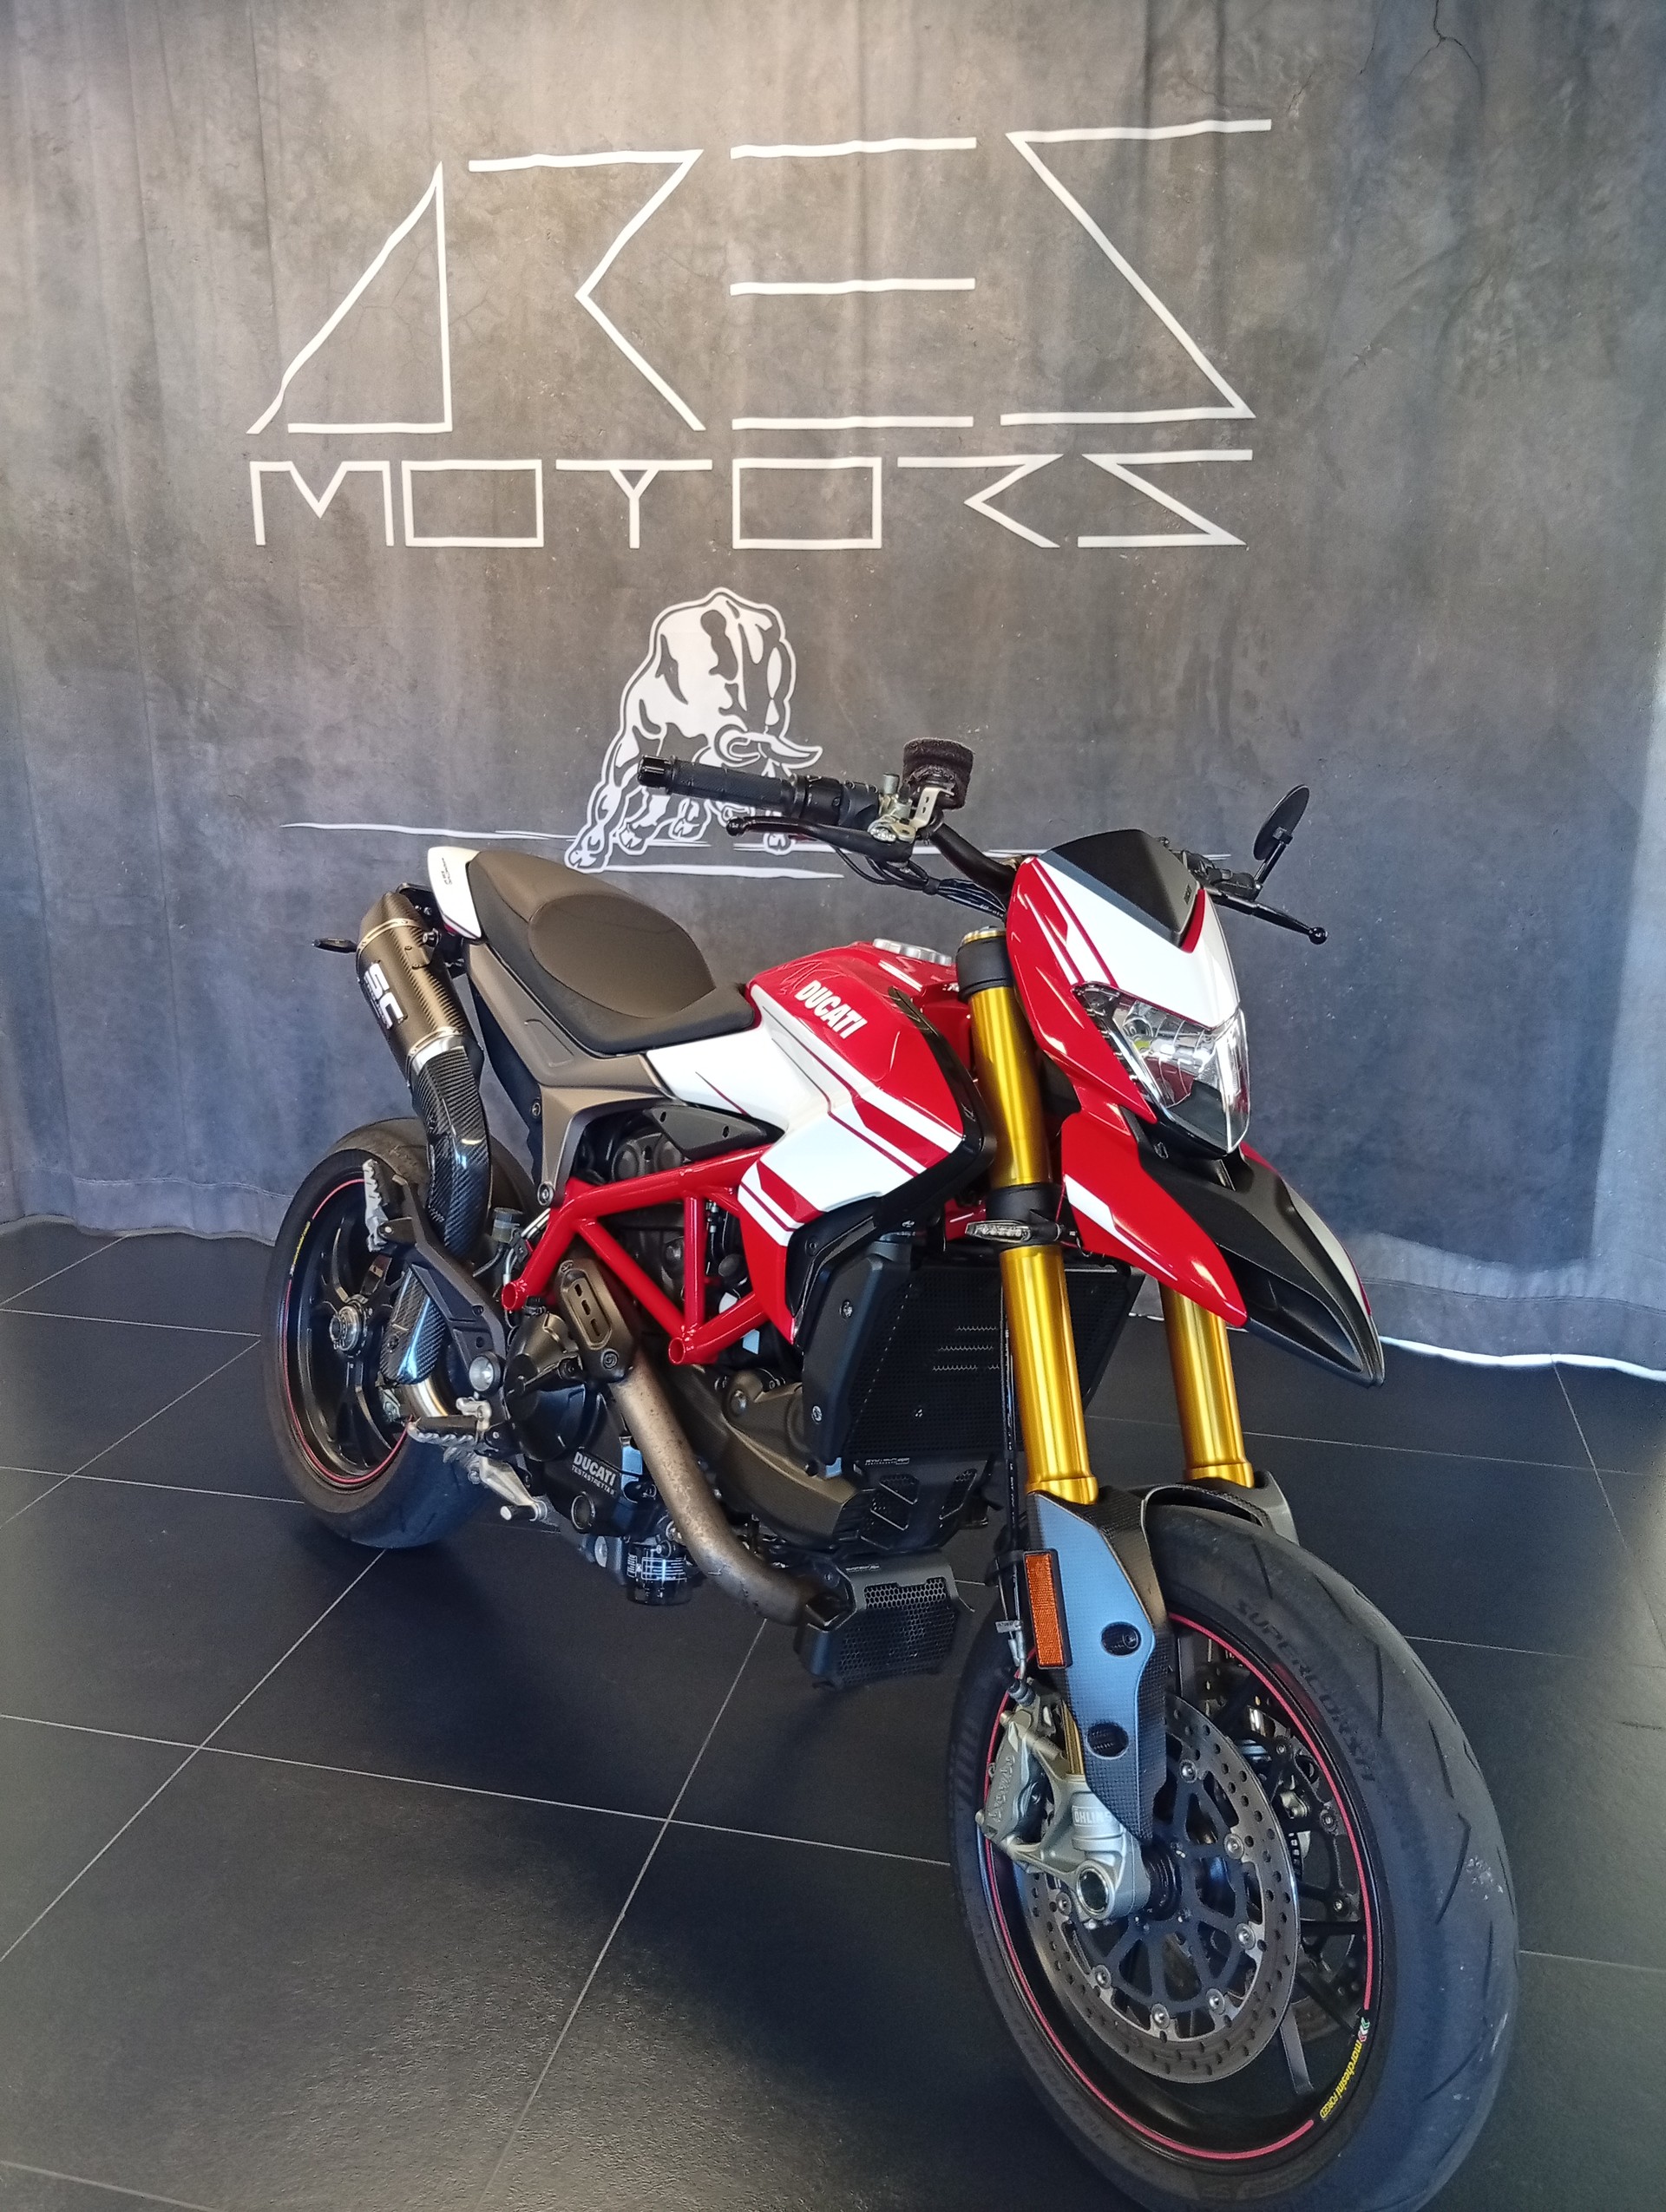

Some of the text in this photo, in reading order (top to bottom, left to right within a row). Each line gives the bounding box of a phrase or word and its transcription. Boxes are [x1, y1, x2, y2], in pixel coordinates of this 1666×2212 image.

[246, 119, 1272, 435] ARES
[364, 962, 403, 1027] SC
[795, 979, 868, 1039] DUCATI
[573, 1451, 616, 1486] DUCATI
[1335, 2039, 1362, 2098] marchesini
